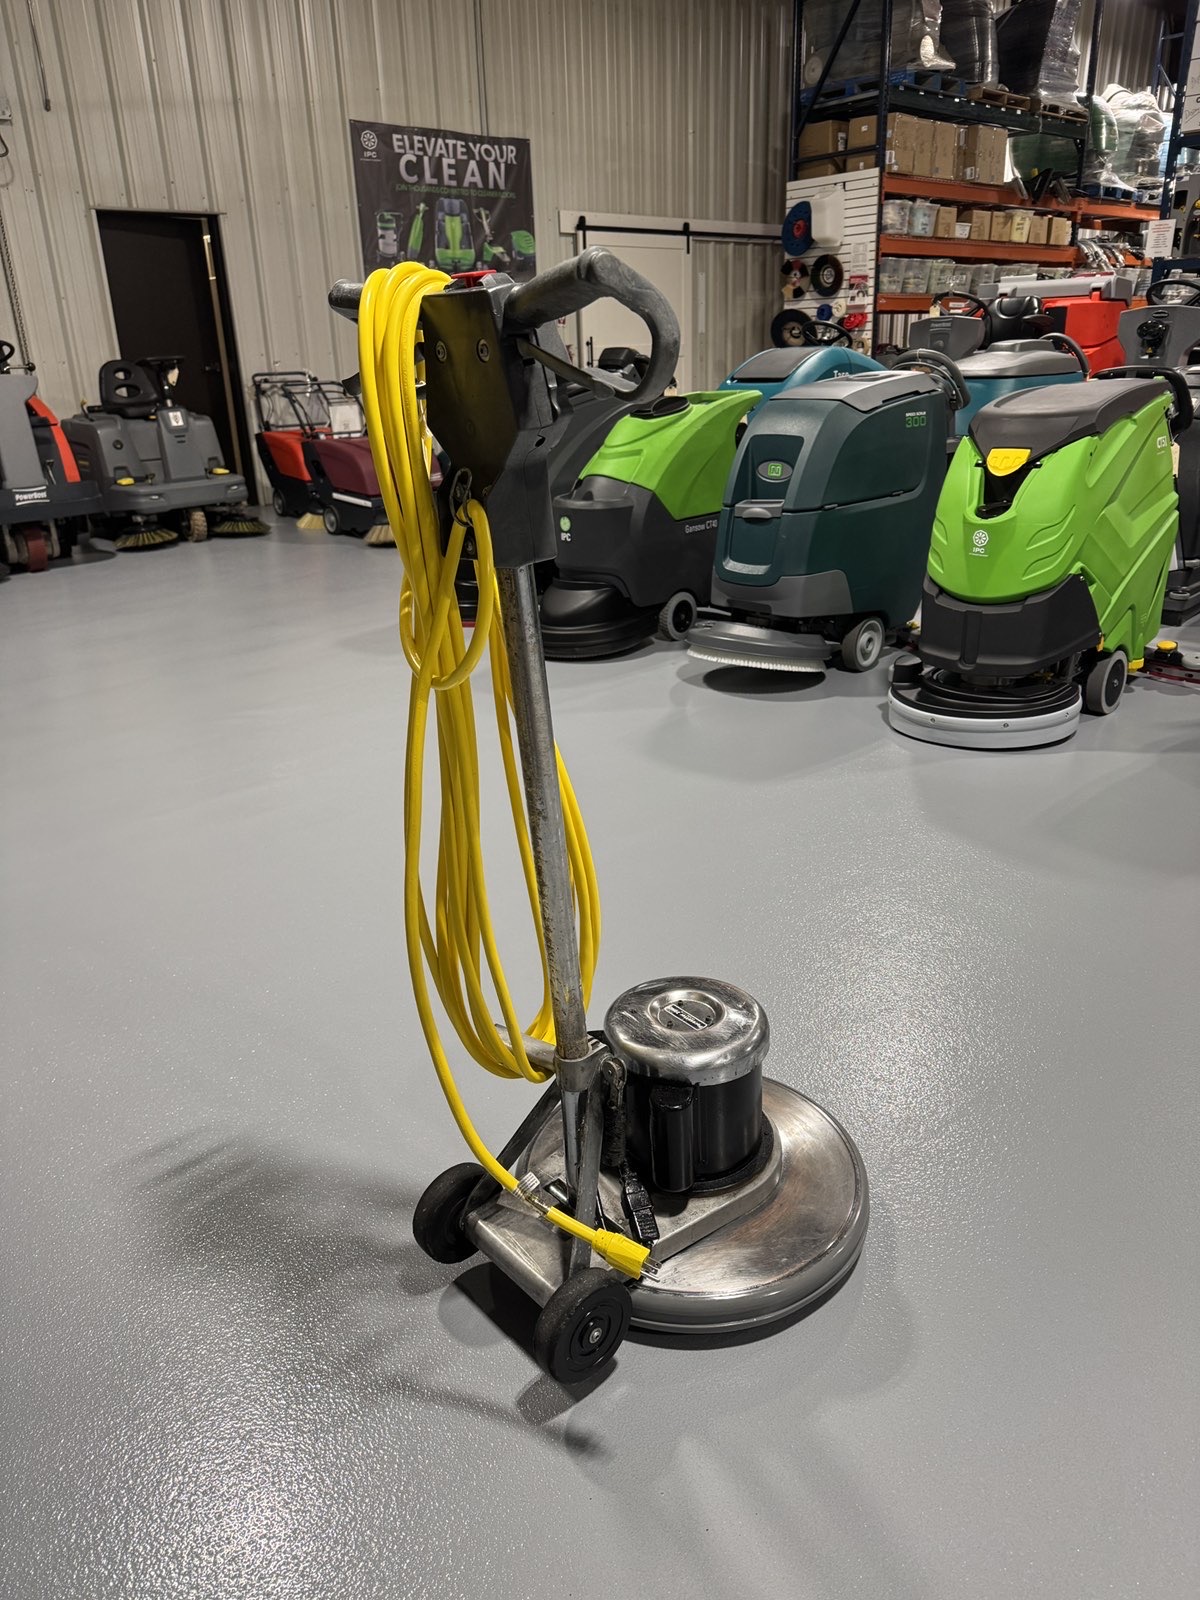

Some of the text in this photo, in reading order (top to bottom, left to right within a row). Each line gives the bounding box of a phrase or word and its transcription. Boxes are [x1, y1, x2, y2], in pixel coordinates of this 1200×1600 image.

[392, 133, 518, 165] ELEVATE YOUR
[399, 153, 506, 190] CLEAN
[905, 416, 927, 428] 300
[560, 532, 571, 541] IPC
